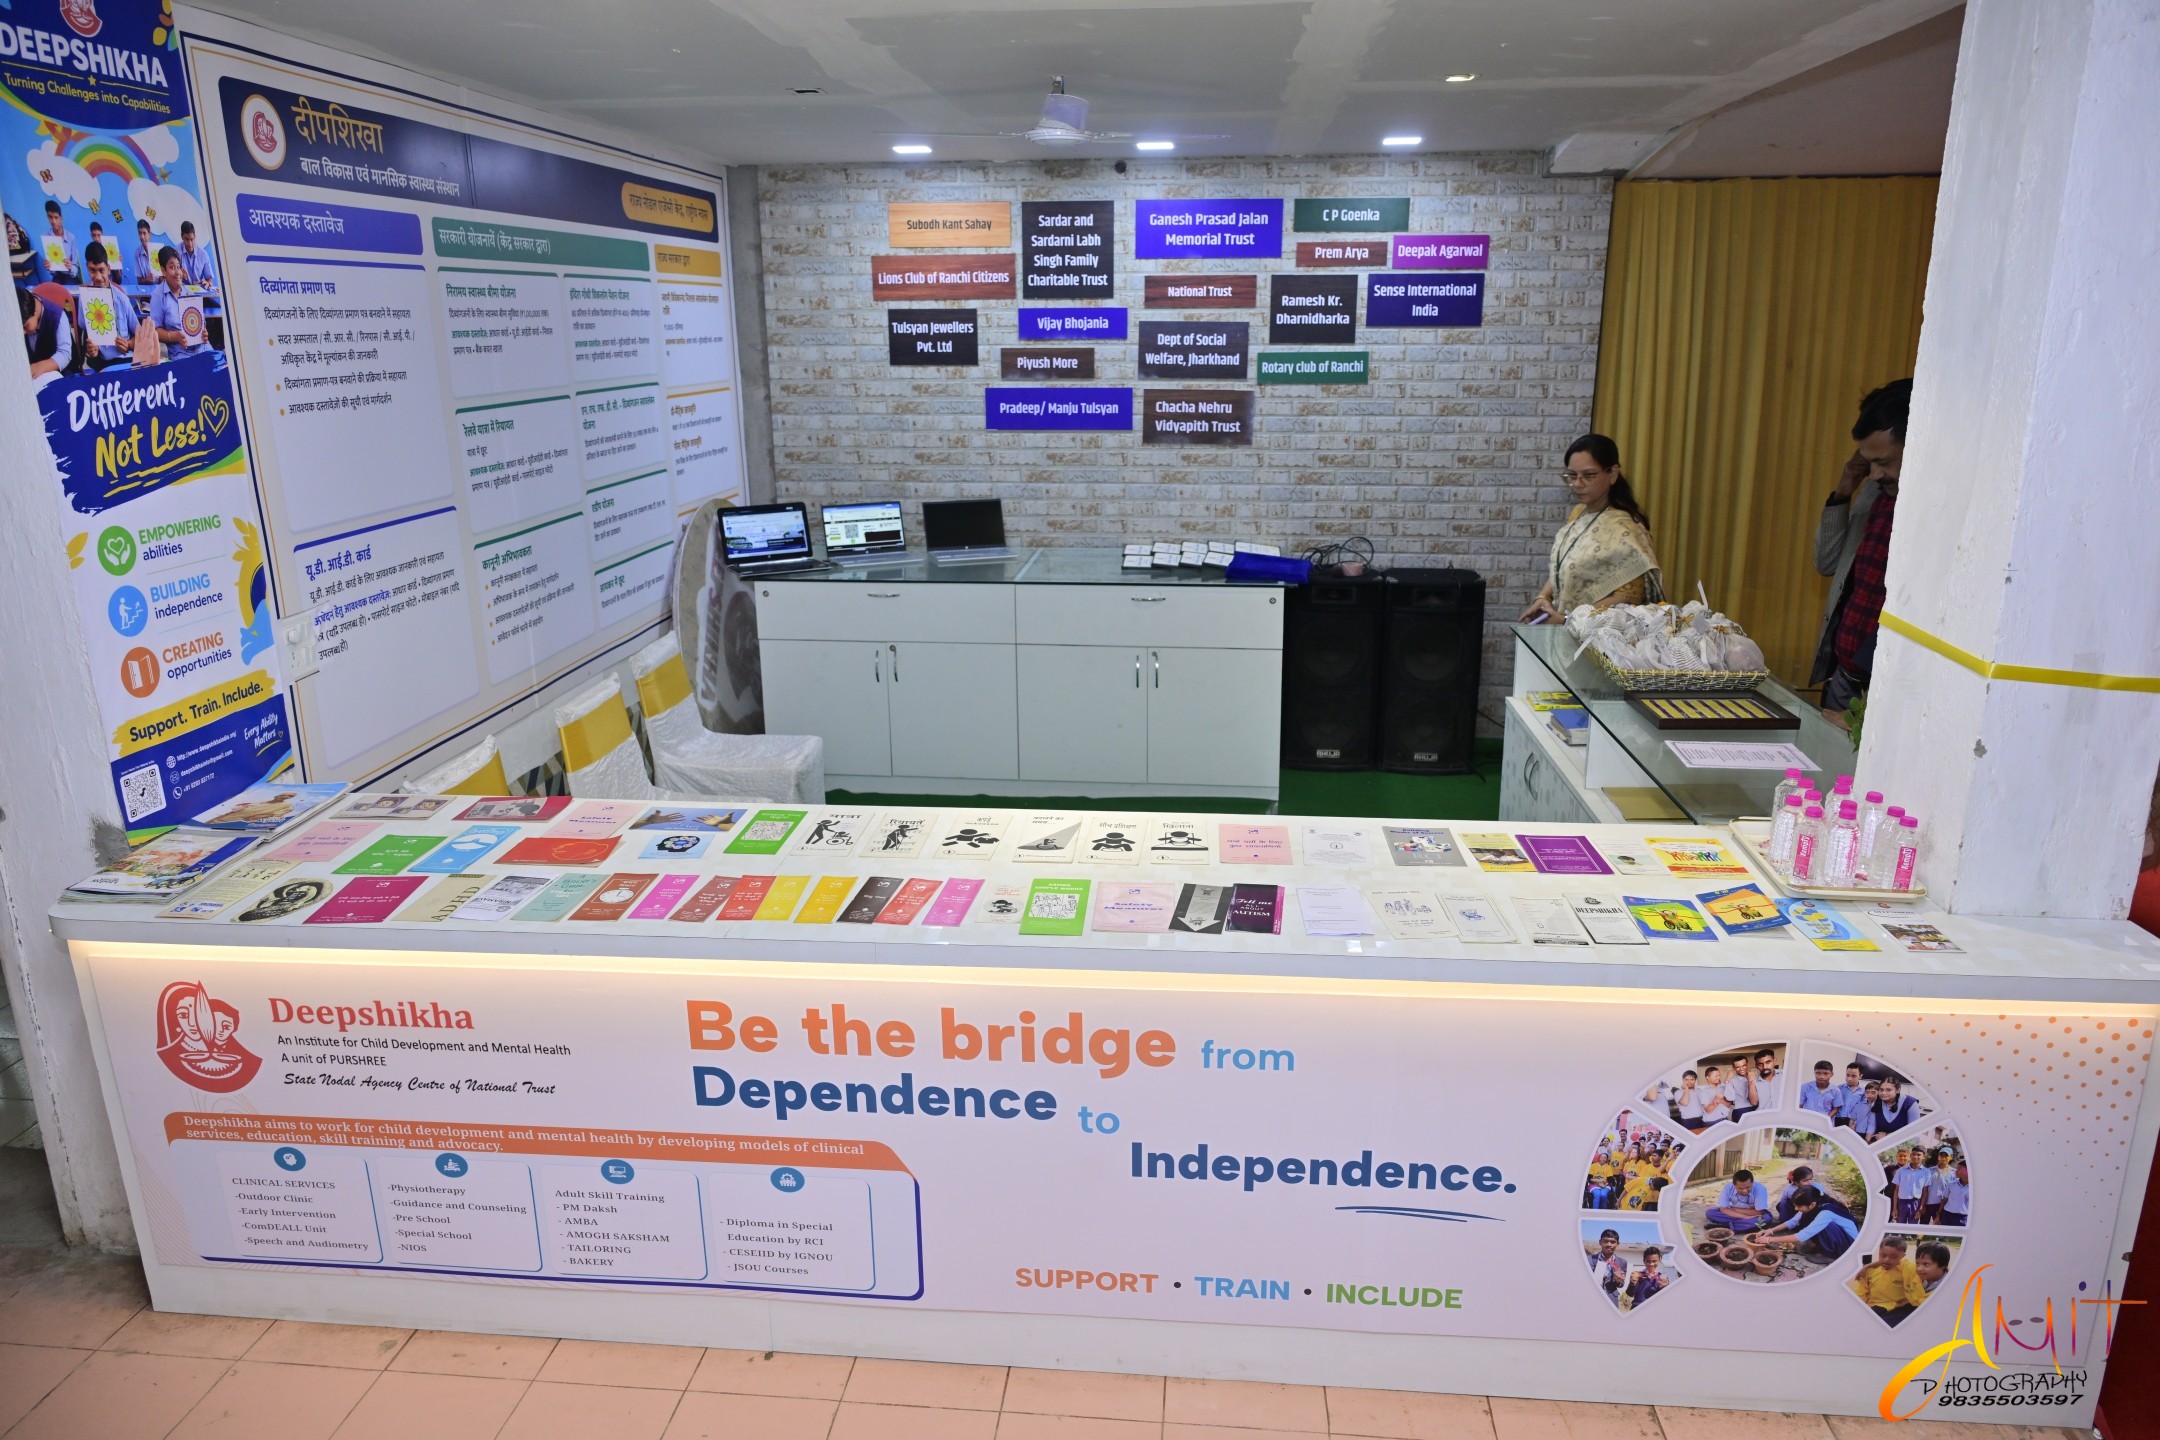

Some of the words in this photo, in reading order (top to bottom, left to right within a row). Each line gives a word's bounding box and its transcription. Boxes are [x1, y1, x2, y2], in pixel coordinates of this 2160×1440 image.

[0, 22, 169, 88] DEEPSHIKHA
[4, 73, 45, 95] Turning
[47, 80, 100, 103] Challenges
[102, 90, 119, 105] into
[121, 95, 171, 115] Capabilities
[249, 209, 300, 230] आवश्यक
[303, 210, 344, 234] दस्तावेज
[1038, 214, 1072, 227] Sardar
[1074, 214, 1093, 227] and
[1150, 213, 1192, 226] Ganesh
[1195, 213, 1235, 226] Prasad
[1238, 212, 1268, 226] Jalan
[1323, 209, 1329, 222] C
[1332, 209, 1338, 222] P
[1341, 209, 1380, 222] Goenka
[907, 218, 940, 230] Subodh
[942, 218, 963, 230] Kant
[964, 217, 992, 232] Sahay
[1031, 234, 1074, 247] Sardarni
[1076, 234, 1101, 247] Labh
[1166, 233, 1221, 246] Memorial
[1224, 233, 1255, 245] Trust
[1315, 247, 1343, 259] Prem
[1345, 246, 1369, 261] Arya
[1398, 245, 1435, 258] Deepak
[1437, 244, 1483, 258] Agarwal
[1034, 254, 1063, 268] Singh
[1065, 254, 1099, 268] Family
[878, 271, 902, 285] Lions
[905, 271, 925, 284] Club
[927, 271, 937, 284] of
[939, 270, 971, 284] Ranchi
[973, 270, 1010, 283] Citizens
[1027, 274, 1079, 287] Charitable
[1082, 274, 1108, 287] Trust
[1168, 285, 1206, 297] National
[1208, 285, 1232, 297] Trust
[1374, 284, 1405, 297] Sense
[1407, 284, 1476, 297] International
[1281, 295, 1324, 307] Ramesh
[1327, 295, 1343, 307] Kr.
[1412, 304, 1438, 317] India
[1037, 317, 1063, 331] Vijay
[1065, 317, 1108, 330] Bhojania
[1276, 313, 1350, 325] Dharnidharka
[892, 322, 928, 335] Tulsyan
[930, 322, 974, 335] Jewellers
[917, 341, 935, 353] Pvt.
[937, 341, 952, 353] Ltd
[1157, 334, 1181, 347] Dept
[1184, 333, 1194, 346] of
[1196, 333, 1226, 346] Social
[1017, 357, 1049, 370] Piyush
[1052, 357, 1078, 368] More
[1145, 353, 1186, 367] Welfare,
[1188, 353, 1240, 367] Jharkhand
[1262, 362, 1293, 375] Rotary
[1296, 362, 1316, 373] club
[1319, 361, 1329, 373] of
[1331, 360, 1363, 373] Ranchi
[1048, 402, 1078, 415] Manju
[1080, 402, 1118, 415] Tulsyan
[1156, 401, 1195, 414] Chacha
[1199, 402, 1232, 414] Nehru
[1156, 420, 1208, 434] Vidyapith
[1211, 420, 1240, 433] Trust
[96, 424, 143, 478] Not
[151, 409, 207, 458] Less!
[138, 514, 221, 545] EMPOWERING
[143, 542, 183, 561] abilities
[150, 573, 210, 603] BUILDING
[154, 591, 223, 619] independence
[162, 632, 224, 664] CREATING
[167, 647, 232, 680] opportunities
[129, 712, 188, 743] Support.
[189, 700, 221, 720] Train.
[222, 680, 264, 706] Include.
[243, 722, 260, 741] Every
[260, 712, 279, 731] Ability
[254, 730, 276, 750] Matters
[1575, 906, 1623, 914] DEEPSHIKHA
[268, 997, 474, 1032] Deepshikha
[686, 998, 778, 1053] Be
[800, 1005, 915, 1057] the
[940, 1008, 1177, 1078] bridge
[1200, 1038, 1297, 1073] from
[277, 1035, 292, 1045] An
[294, 1036, 340, 1048] Institute
[342, 1037, 358, 1048] for
[360, 1037, 388, 1049] Child
[391, 1038, 465, 1055] Development
[468, 1041, 489, 1053] and
[491, 1042, 531, 1054] Mental
[534, 1043, 571, 1056] Health
[284, 1074, 317, 1086] State
[319, 1073, 356, 1087] Nodal
[360, 1075, 402, 1092] Agency
[408, 1076, 447, 1091] Centre
[449, 1078, 461, 1095] of
[464, 1079, 517, 1093] National
[521, 1081, 556, 1094] Trust
[691, 1065, 1057, 1120] Dependence
[1077, 1104, 1121, 1134] to
[184, 1116, 261, 1130] Deepshikha
[264, 1118, 297, 1129] aims
[299, 1120, 313, 1130] to
[316, 1120, 351, 1131] work
[355, 1121, 374, 1132] for
[378, 1123, 412, 1135] child
[415, 1124, 504, 1140] development
[508, 1128, 534, 1140] and
[537, 1130, 586, 1142] mental
[589, 1132, 633, 1145] health
[637, 1134, 655, 1148] by
[658, 1135, 736, 1152] developing
[739, 1139, 790, 1152] models
[794, 1141, 809, 1153] of
[811, 1142, 864, 1155] clinical
[1131, 1141, 1518, 1194] Independence.
[555, 1189, 585, 1199] Adult
[588, 1190, 614, 1200] Skill
[616, 1193, 665, 1204] Training
[563, 1203, 580, 1212] PM
[583, 1204, 618, 1213] Daksh
[565, 1217, 599, 1226] AMBA
[566, 1230, 610, 1240] AMOGH
[613, 1232, 670, 1243] SAKSHAM
[568, 1243, 632, 1254] TAILORING
[569, 1257, 614, 1268] BAKERY
[1015, 1266, 1159, 1293] SUPPORT
[1194, 1275, 1291, 1301] TRAIN
[1326, 1282, 1463, 1309] INCLUDE
